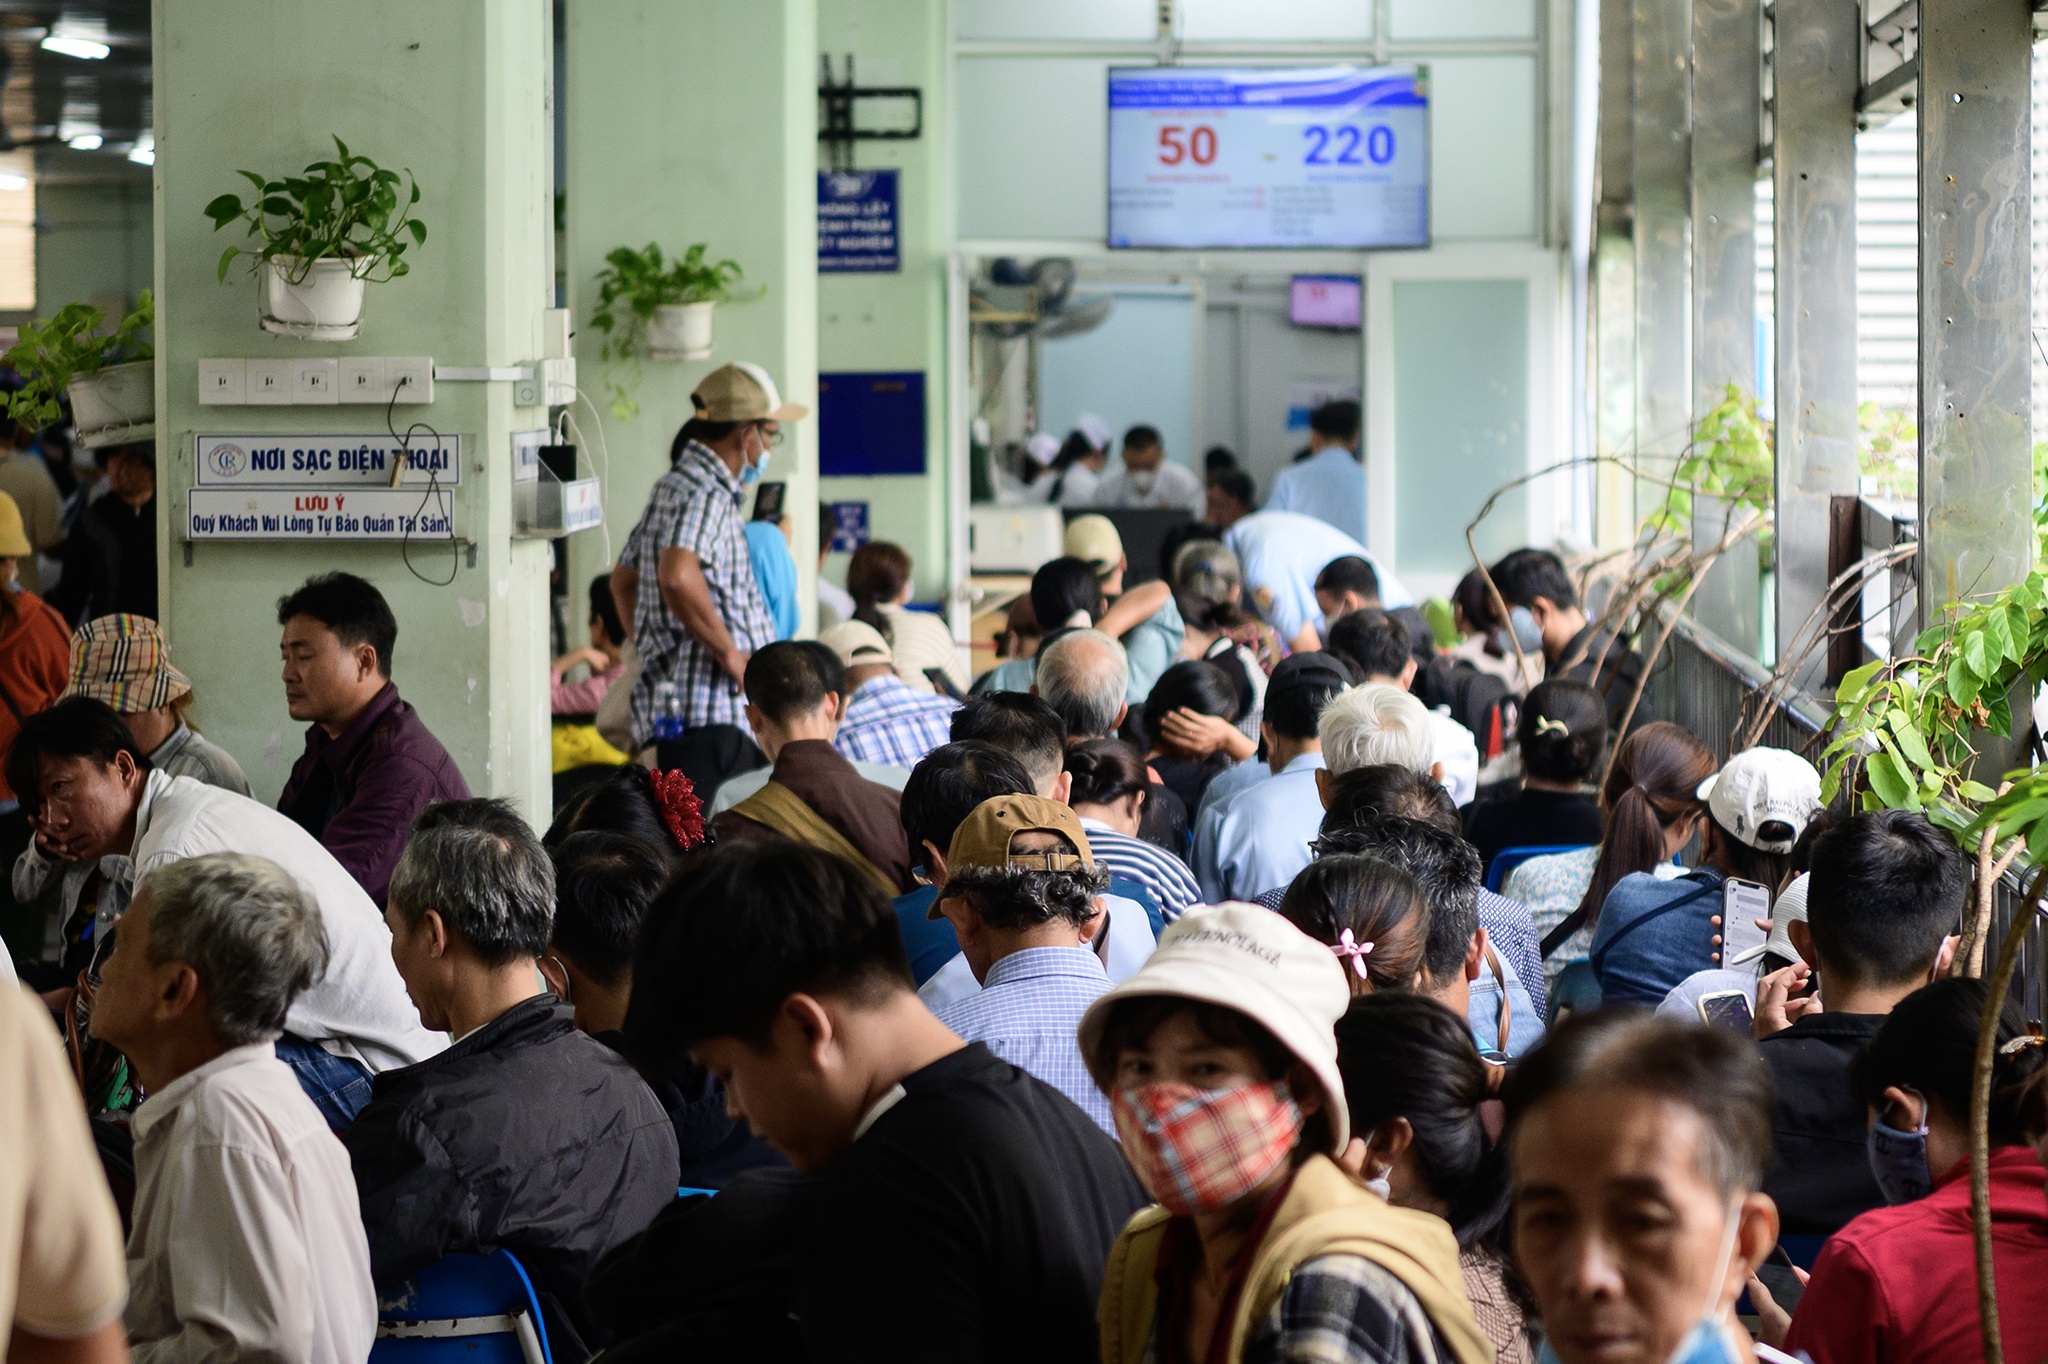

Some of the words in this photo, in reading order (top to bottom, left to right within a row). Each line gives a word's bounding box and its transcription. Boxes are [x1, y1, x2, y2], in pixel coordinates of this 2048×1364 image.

[1158, 124, 1219, 166] 50
[1303, 124, 1396, 166] 220
[251, 447, 285, 471] NƠI
[292, 449, 332, 475] SẠC
[338, 444, 385, 475] ĐIỆN
[295, 495, 328, 511] LƯU
[335, 493, 345, 511] Ý
[193, 514, 215, 534] Quý
[219, 514, 257, 532] Khách
[262, 515, 279, 532] Vui
[284, 514, 313, 534] Lòng
[317, 515, 332, 536] Tự
[336, 513, 359, 532] Bảo
[363, 513, 394, 533] Quản
[399, 515, 416, 532] Tài
